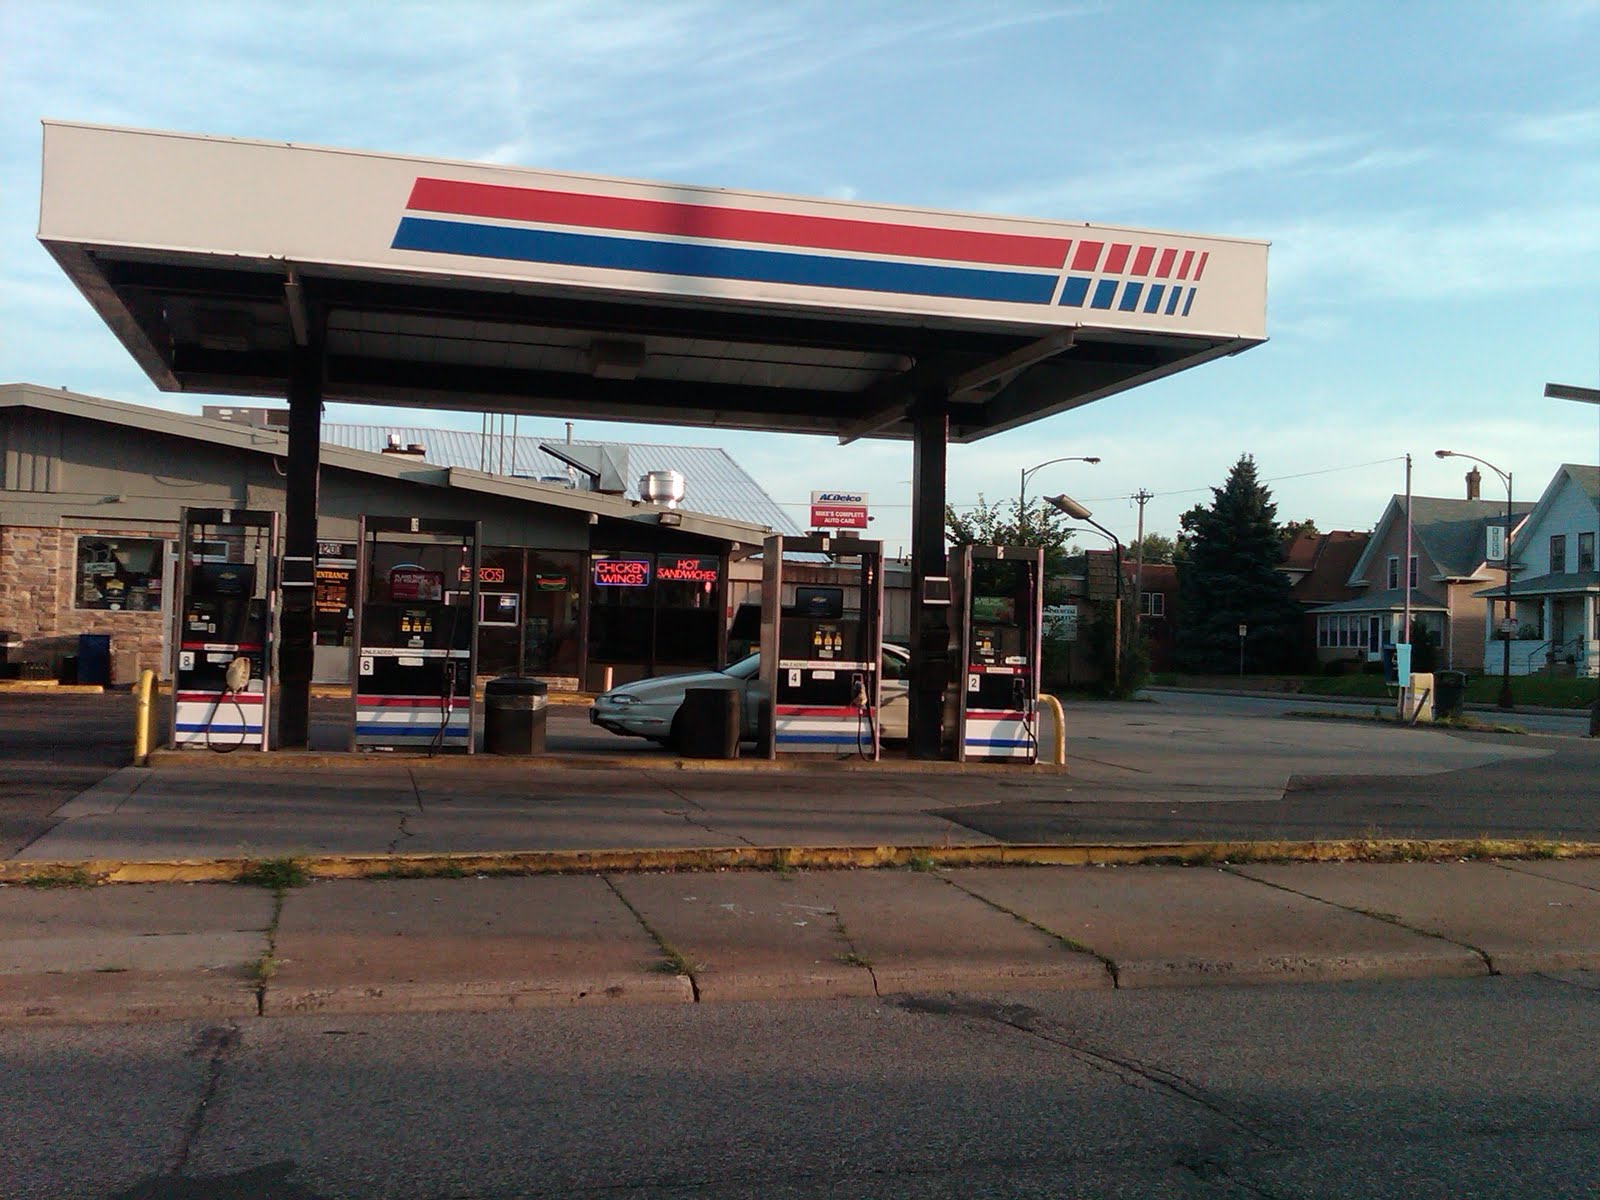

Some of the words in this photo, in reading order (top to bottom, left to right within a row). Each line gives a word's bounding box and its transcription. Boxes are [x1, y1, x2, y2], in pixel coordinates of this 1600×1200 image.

[819, 494, 862, 502] ACDelco
[597, 562, 648, 573] CHICKEN
[677, 560, 700, 569] HOT
[316, 570, 349, 580] ENTRANCE
[601, 574, 644, 583] WINGS
[658, 568, 717, 579] SANDWICHES
[183, 656, 190, 666] 8
[362, 660, 370, 671] 6
[791, 673, 797, 682] 4
[971, 677, 977, 688] 2
